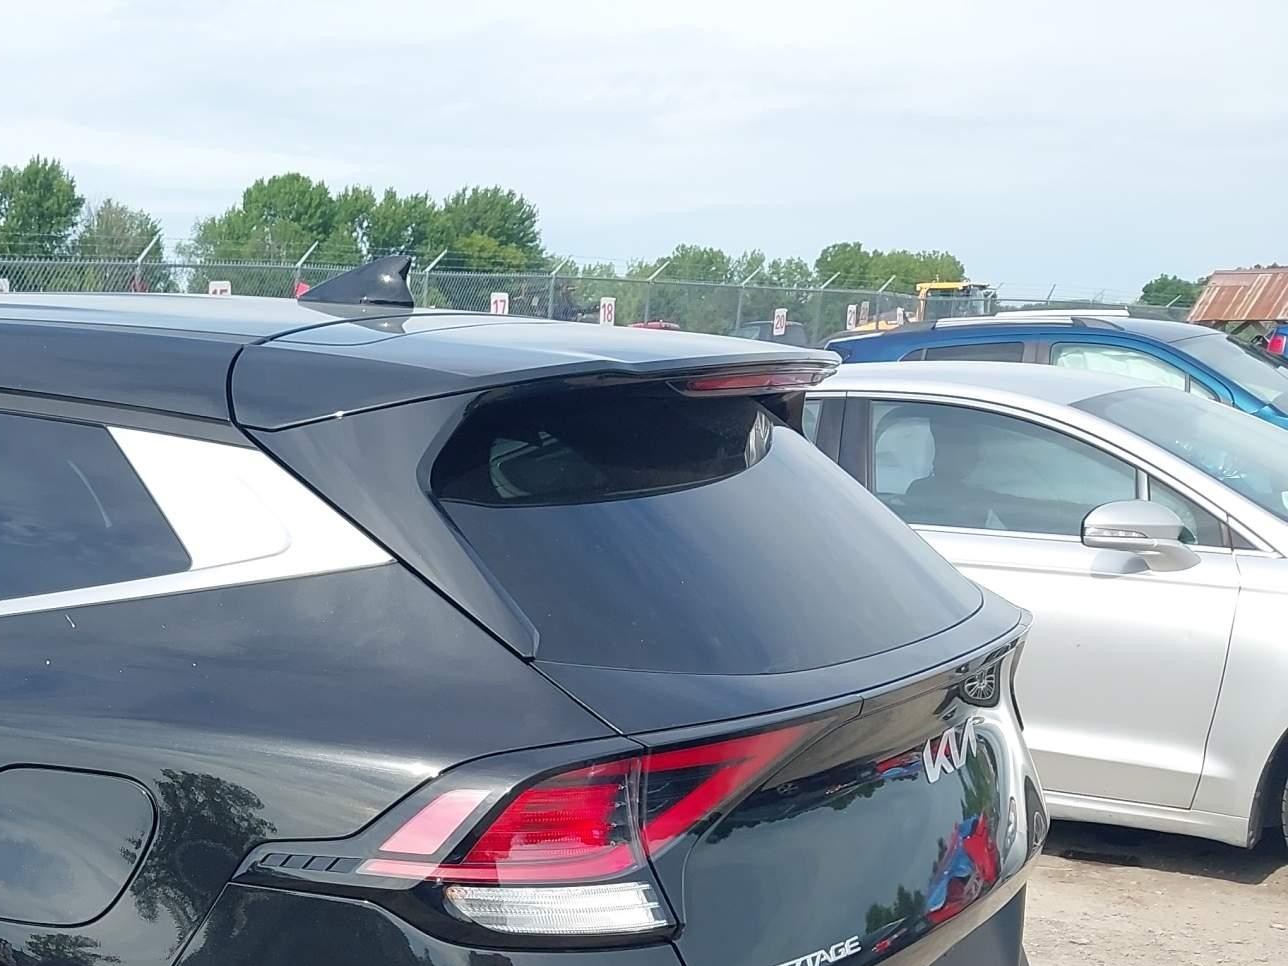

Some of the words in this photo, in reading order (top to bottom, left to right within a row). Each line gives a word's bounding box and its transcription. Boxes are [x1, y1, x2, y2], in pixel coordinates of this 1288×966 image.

[602, 303, 613, 322] 18
[775, 314, 785, 330] 20
[923, 717, 977, 784] KIA
